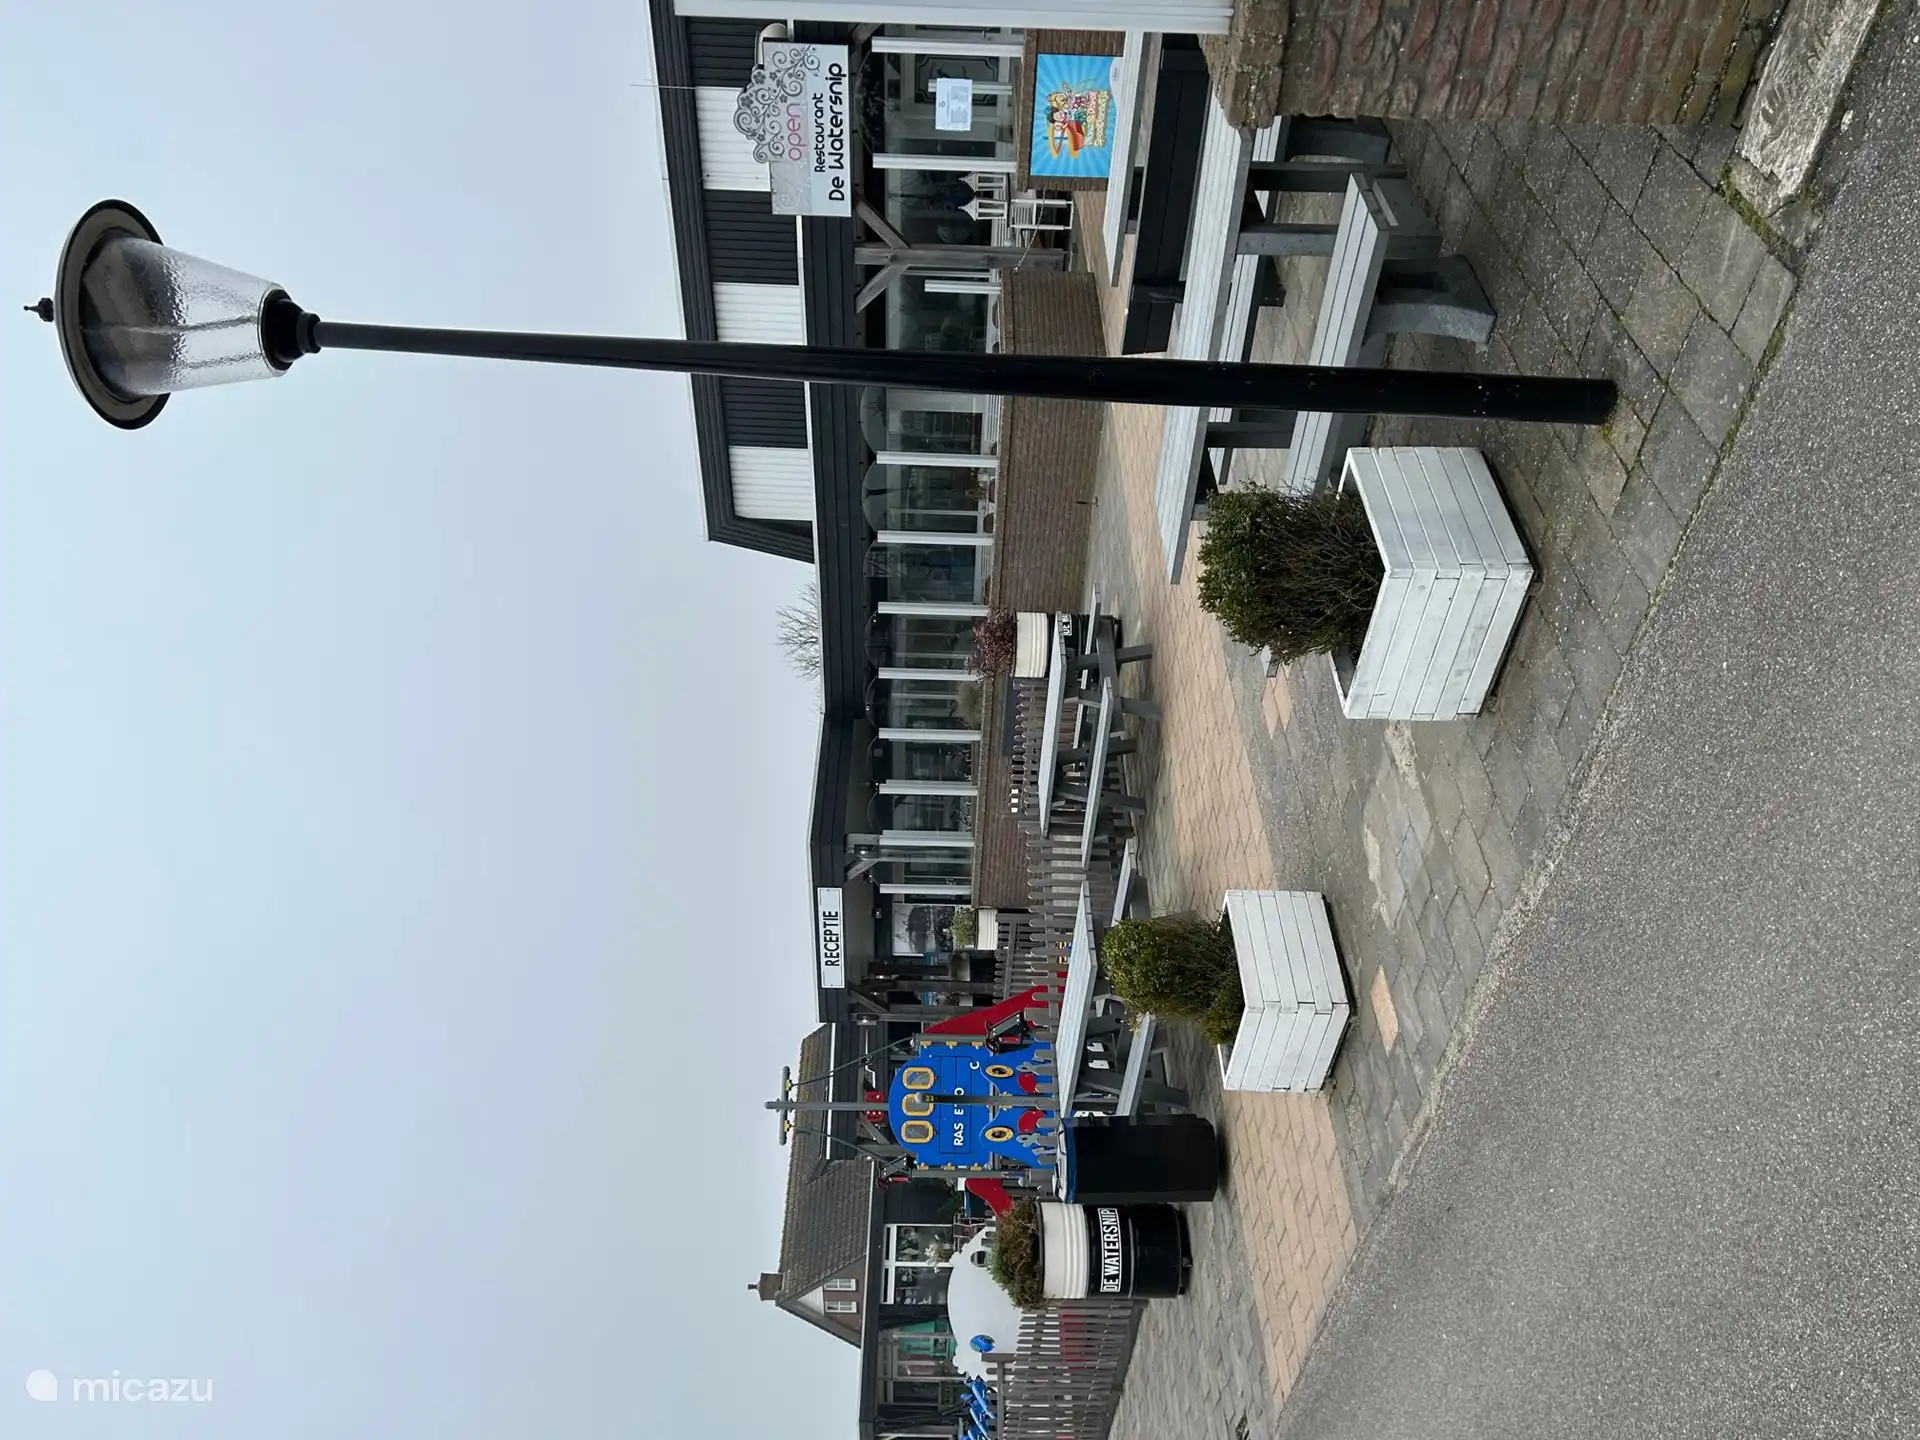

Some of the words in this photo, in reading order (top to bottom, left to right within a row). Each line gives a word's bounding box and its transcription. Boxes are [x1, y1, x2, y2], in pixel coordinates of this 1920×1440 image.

[786, 103, 806, 160] open
[812, 92, 826, 172] Restaurant
[825, 63, 846, 170] Watersnip
[828, 176, 844, 201] De
[822, 911, 840, 967] RECEPTIE
[954, 1122, 964, 1146] RAS
[1101, 1209, 1119, 1276] WATERSNIP
[1103, 1279, 1118, 1290] DE
